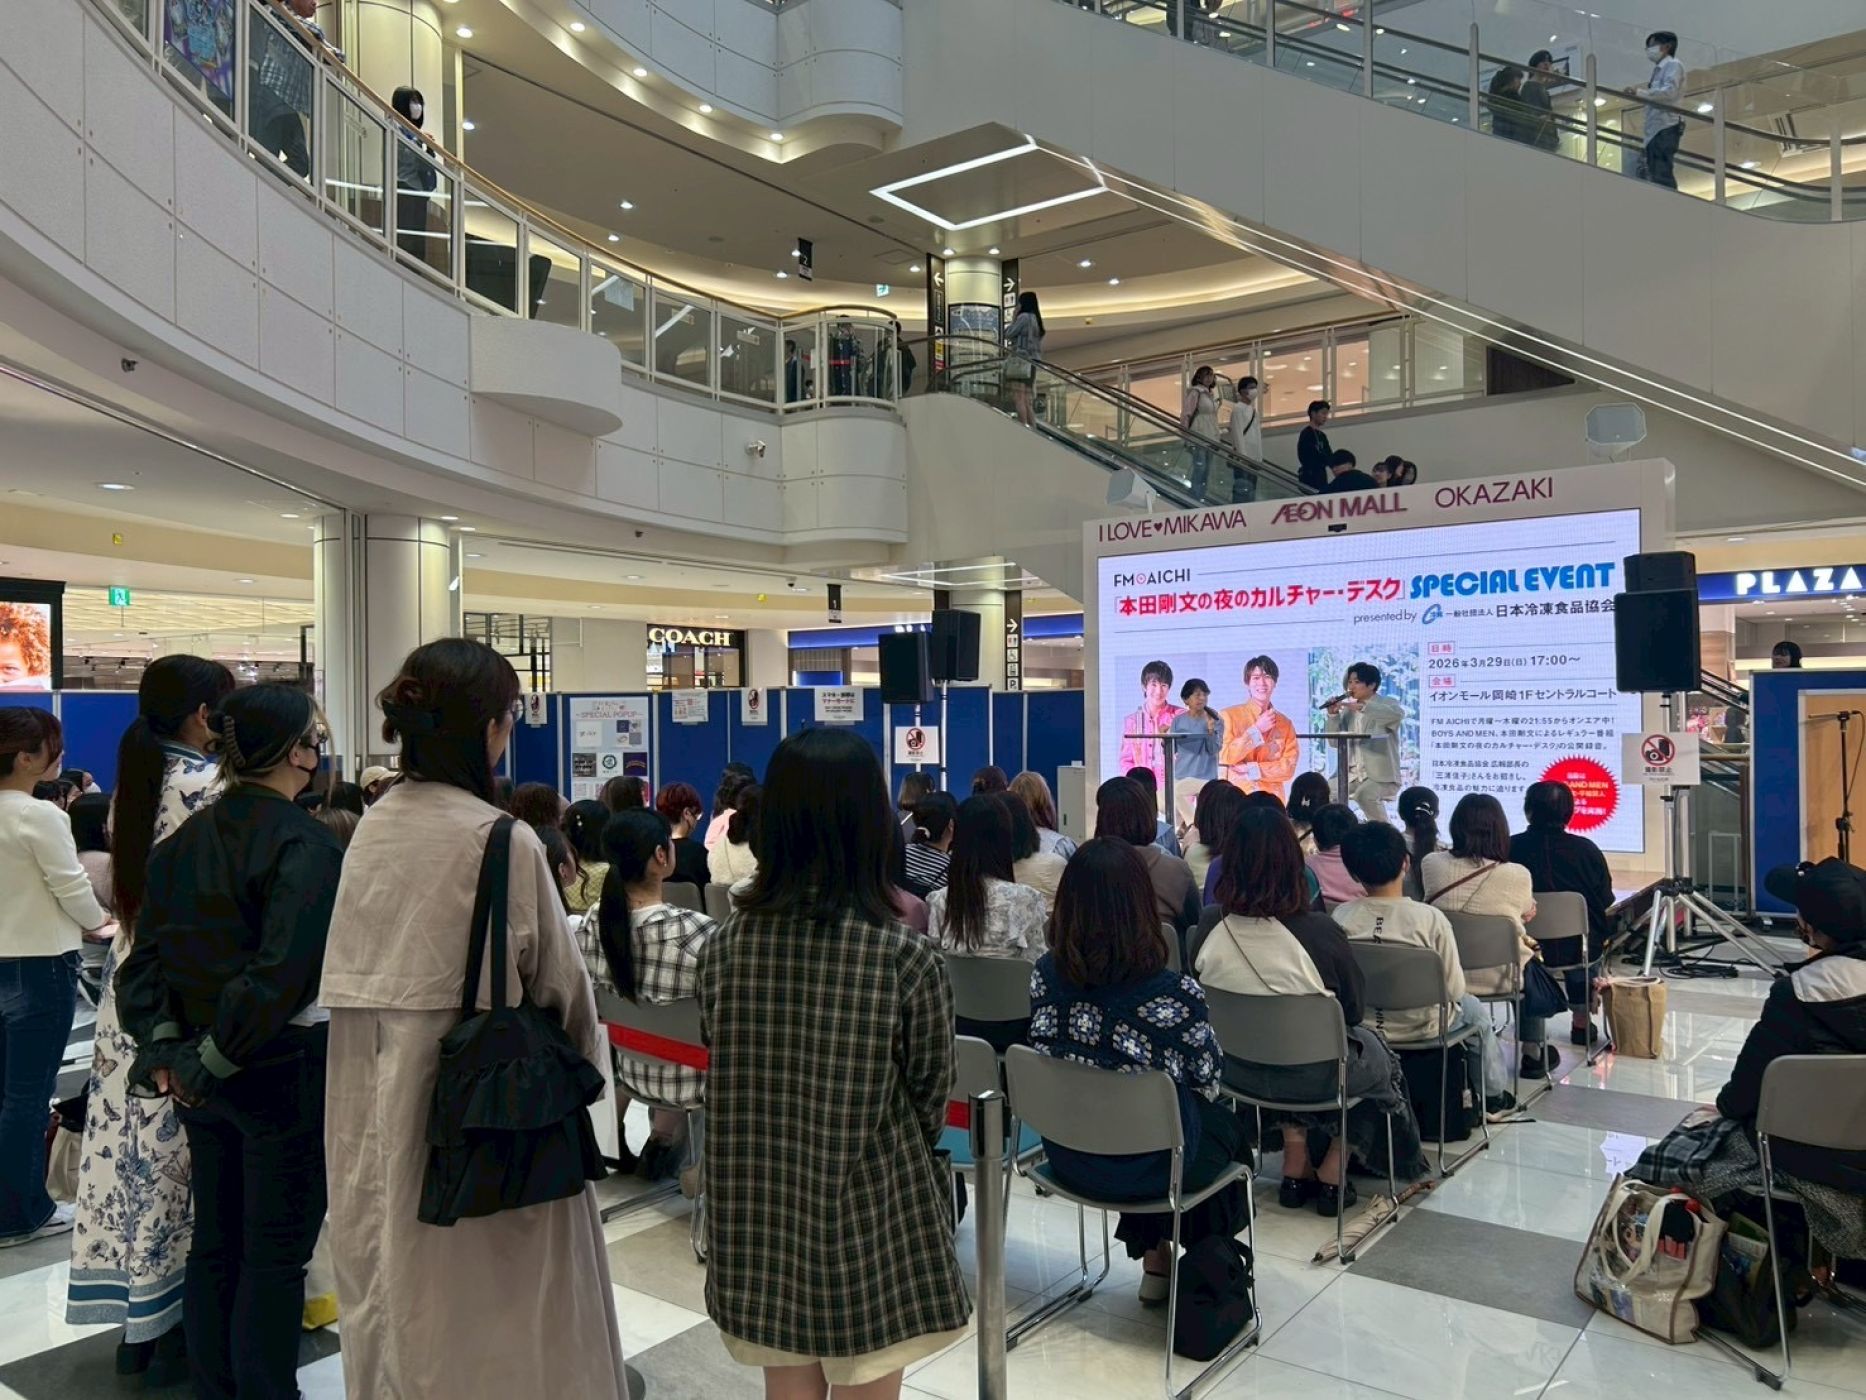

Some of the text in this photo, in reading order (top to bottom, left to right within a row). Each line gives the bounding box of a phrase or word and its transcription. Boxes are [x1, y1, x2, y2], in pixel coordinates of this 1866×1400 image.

[1340, 492, 1408, 518] MALL
[1435, 477, 1553, 508] OKAZAKI
[1098, 509, 1247, 542] I LOVE MIKAWA
[1410, 562, 1616, 600] SPECIAL EVENT
[1736, 566, 1863, 596] PLAZA
[1353, 611, 1403, 626] presented
[1404, 610, 1417, 624] by
[1496, 598, 1616, 618] 日本冷凍食品協会
[648, 627, 731, 647] COACH
